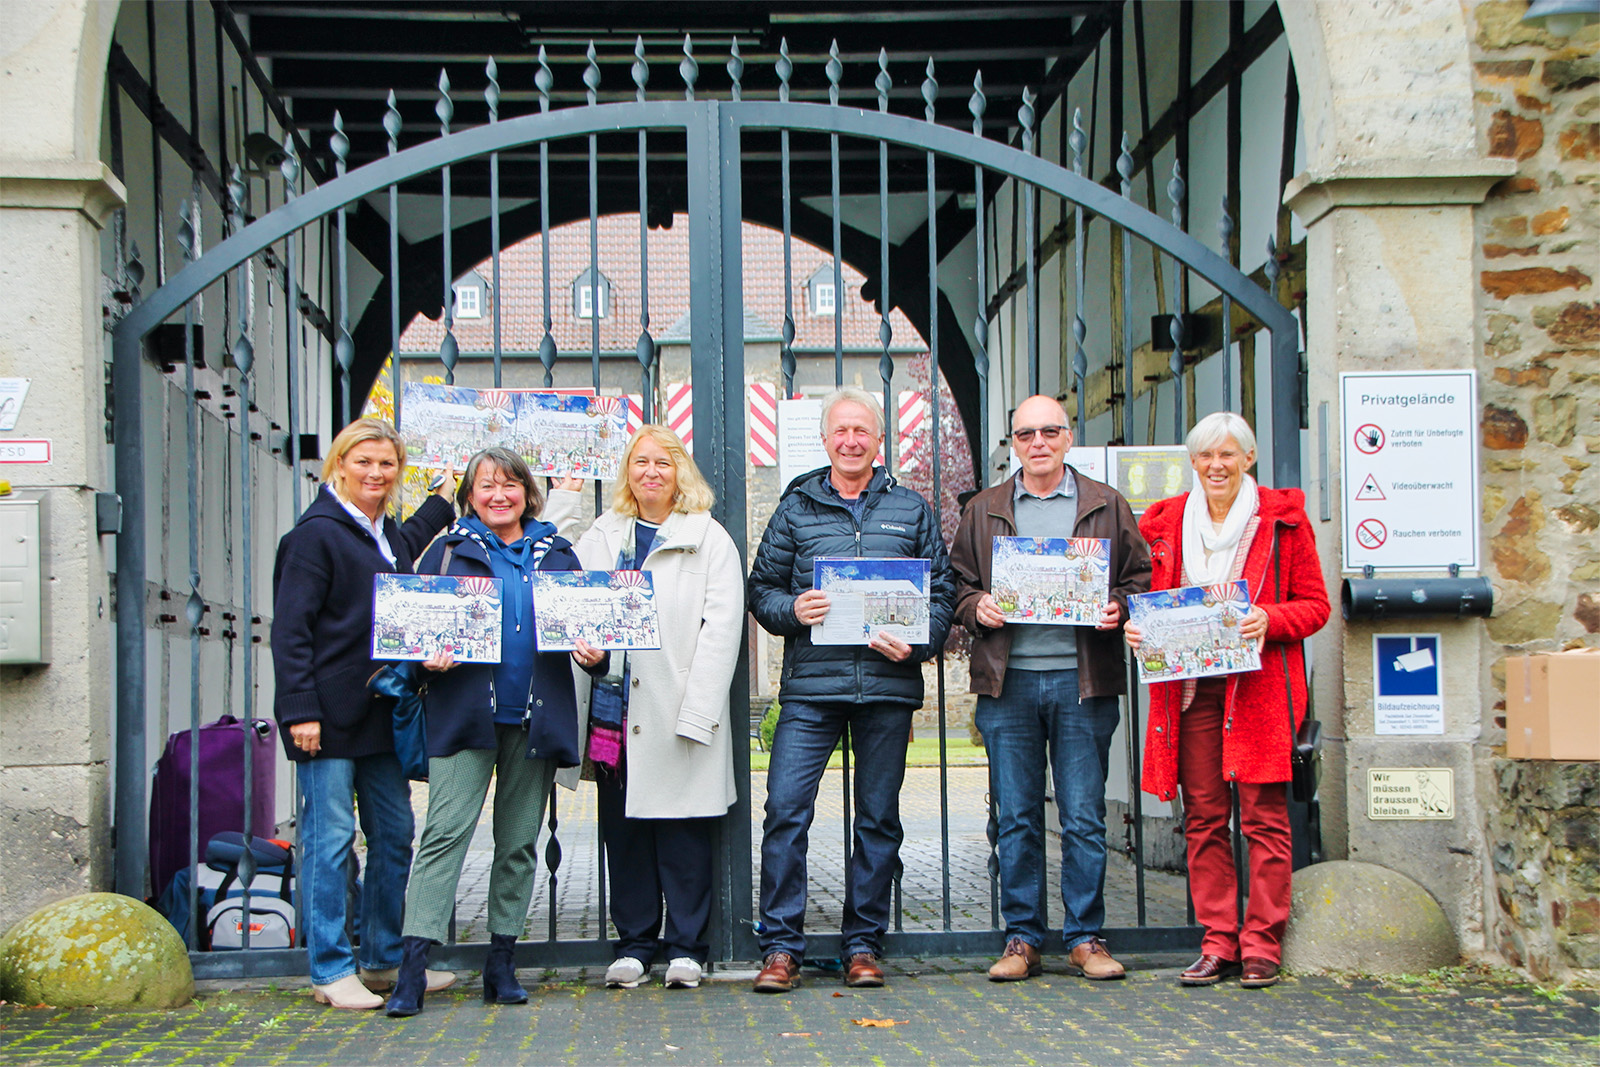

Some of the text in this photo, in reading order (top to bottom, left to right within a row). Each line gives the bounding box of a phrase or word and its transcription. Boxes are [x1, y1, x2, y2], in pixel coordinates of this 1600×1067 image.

[1361, 394, 1455, 407] Privatgelände
[1390, 429, 1464, 439] Zutritt für Unbefugte
[1391, 481, 1453, 490] Videoüberwacht
[1392, 529, 1461, 538] Rauchen verboten
[1377, 702, 1440, 712] Bildaufzeichnung
[1372, 773, 1391, 782] Wir
[1372, 784, 1411, 793] müssen
[1372, 795, 1419, 804] draussen
[1373, 806, 1410, 815] bleiben
